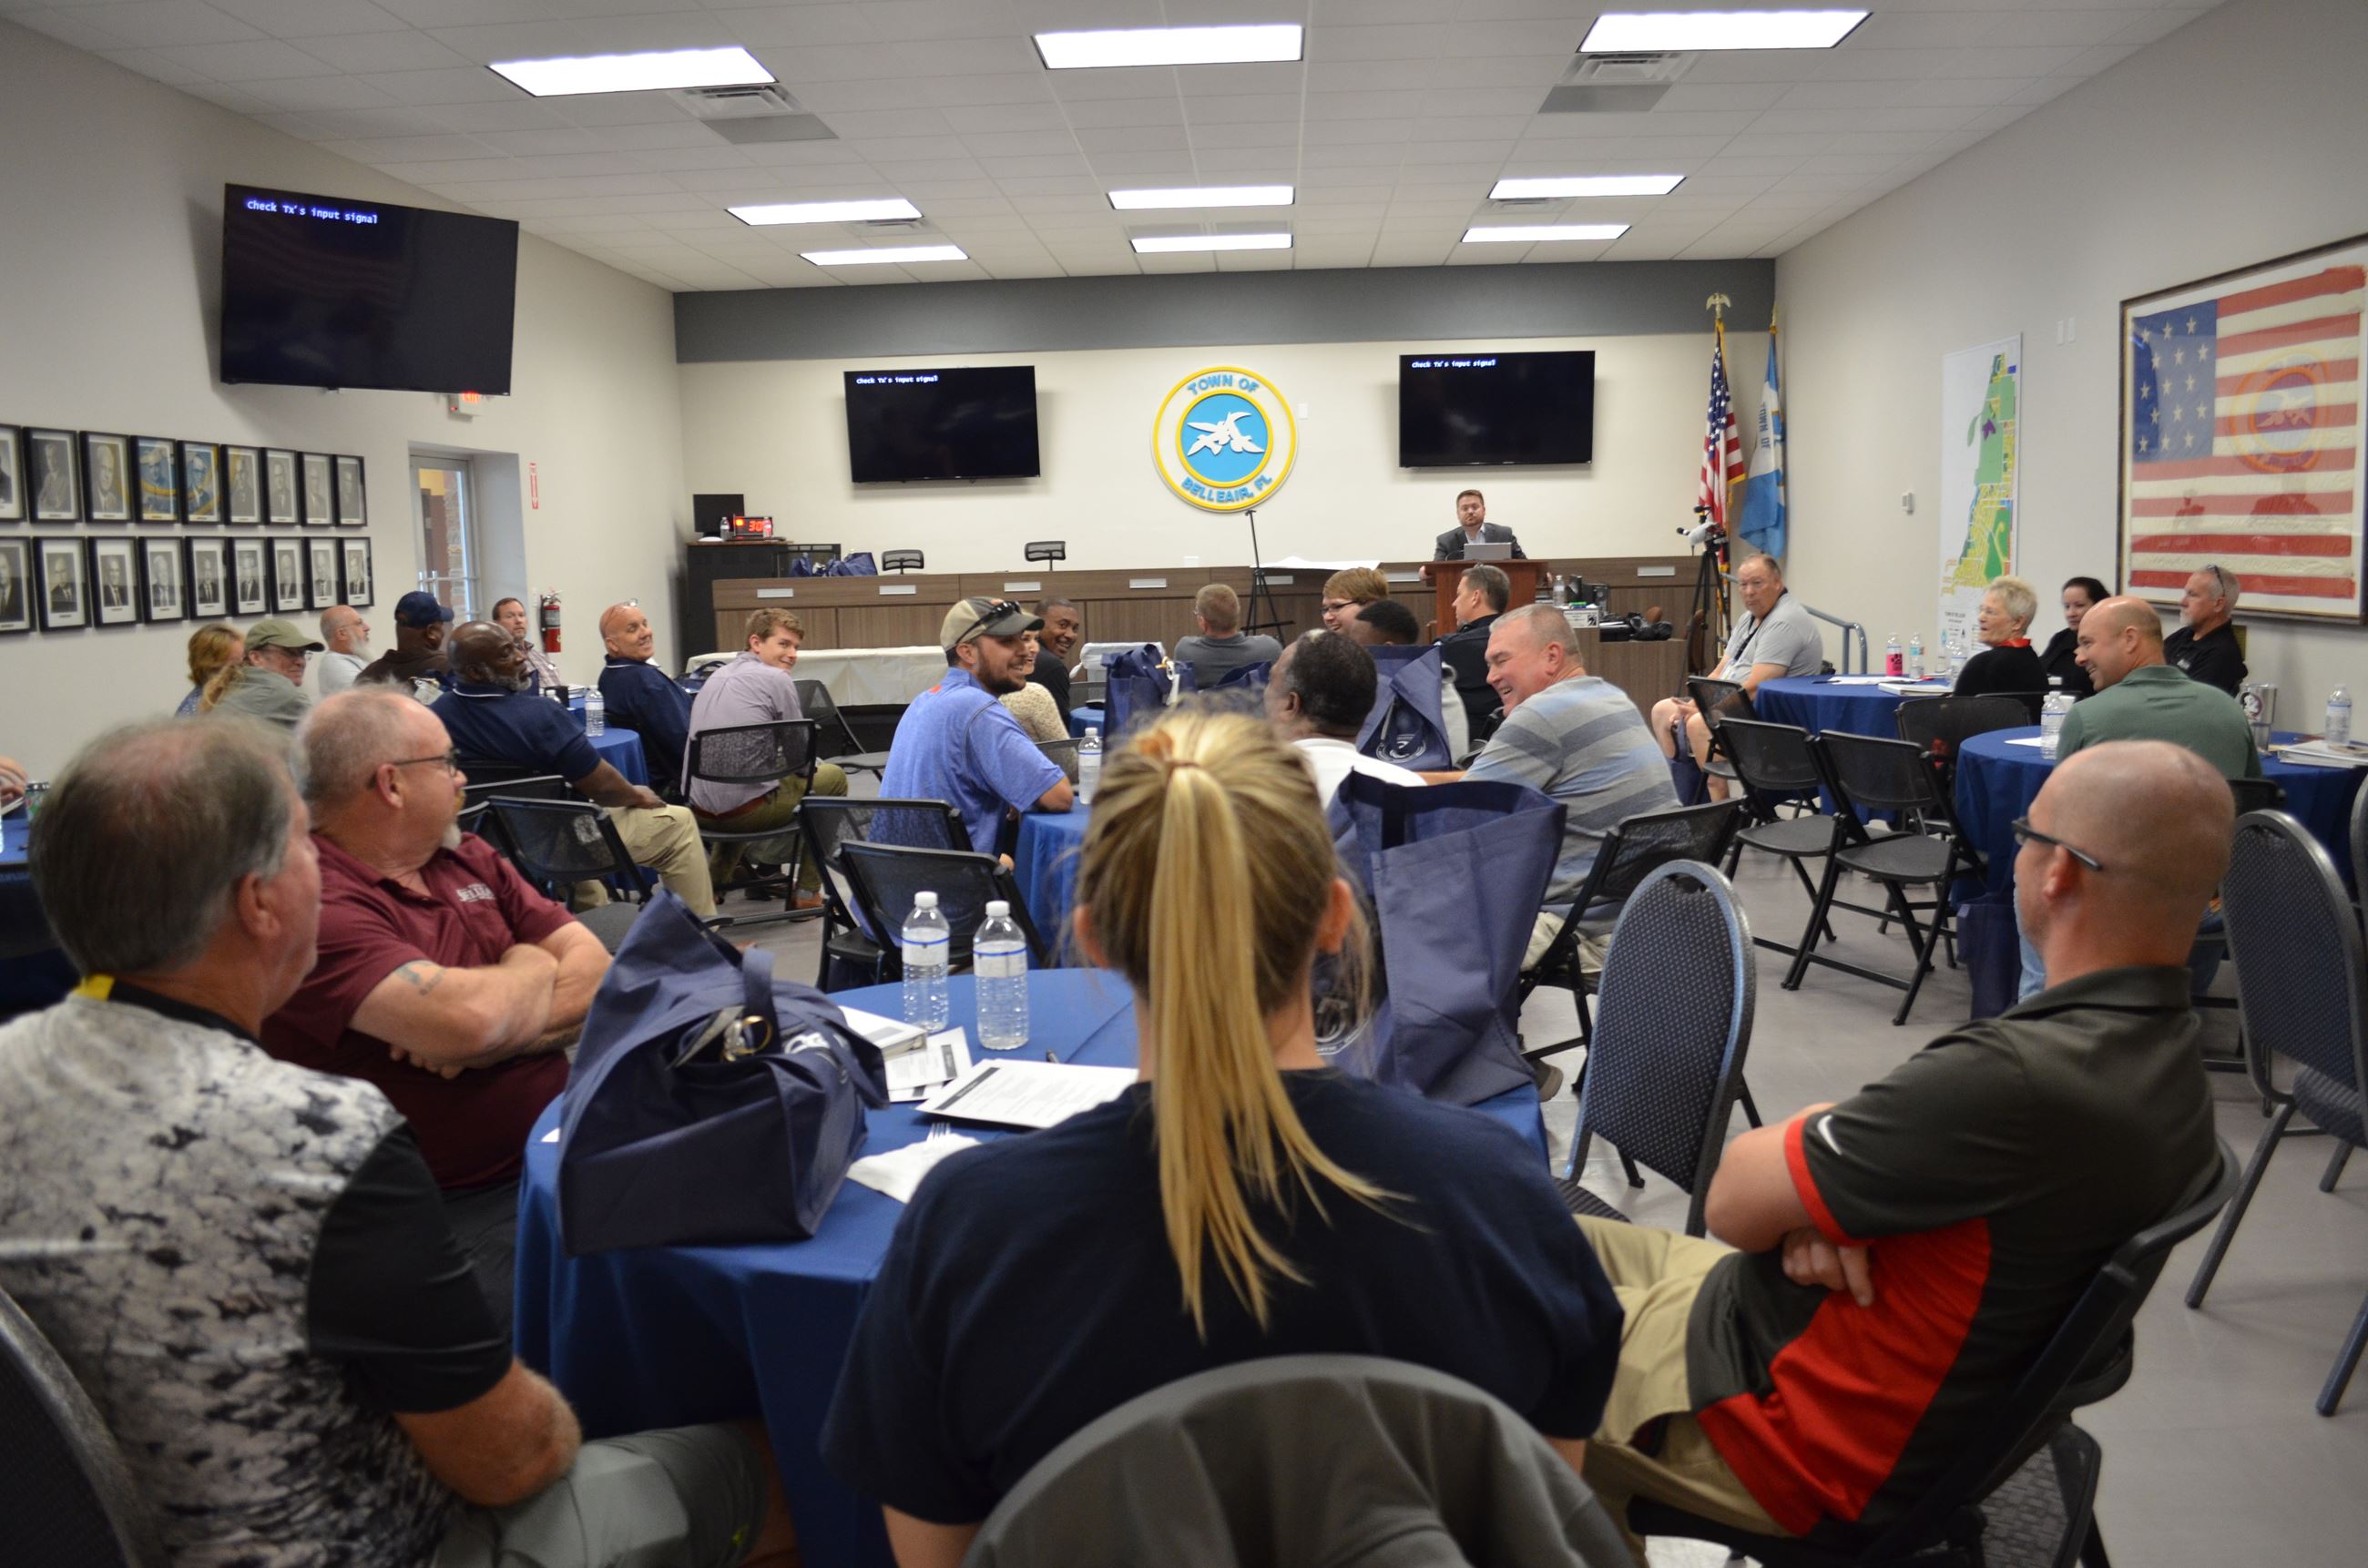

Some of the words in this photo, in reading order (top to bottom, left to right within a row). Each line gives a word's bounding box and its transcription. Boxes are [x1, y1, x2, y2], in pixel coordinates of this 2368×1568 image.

[246, 199, 278, 213] Check
[282, 204, 307, 216] Tx's
[311, 207, 341, 220] input
[344, 211, 379, 225] signal
[1411, 360, 1432, 369] Check
[1451, 360, 1472, 368] input
[1473, 358, 1496, 368] signal
[856, 376, 875, 384] Check
[894, 376, 914, 384] input
[915, 374, 939, 383] signal
[1187, 374, 1233, 395] TOWN
[1238, 378, 1260, 392] OF
[1254, 474, 1272, 491] FL
